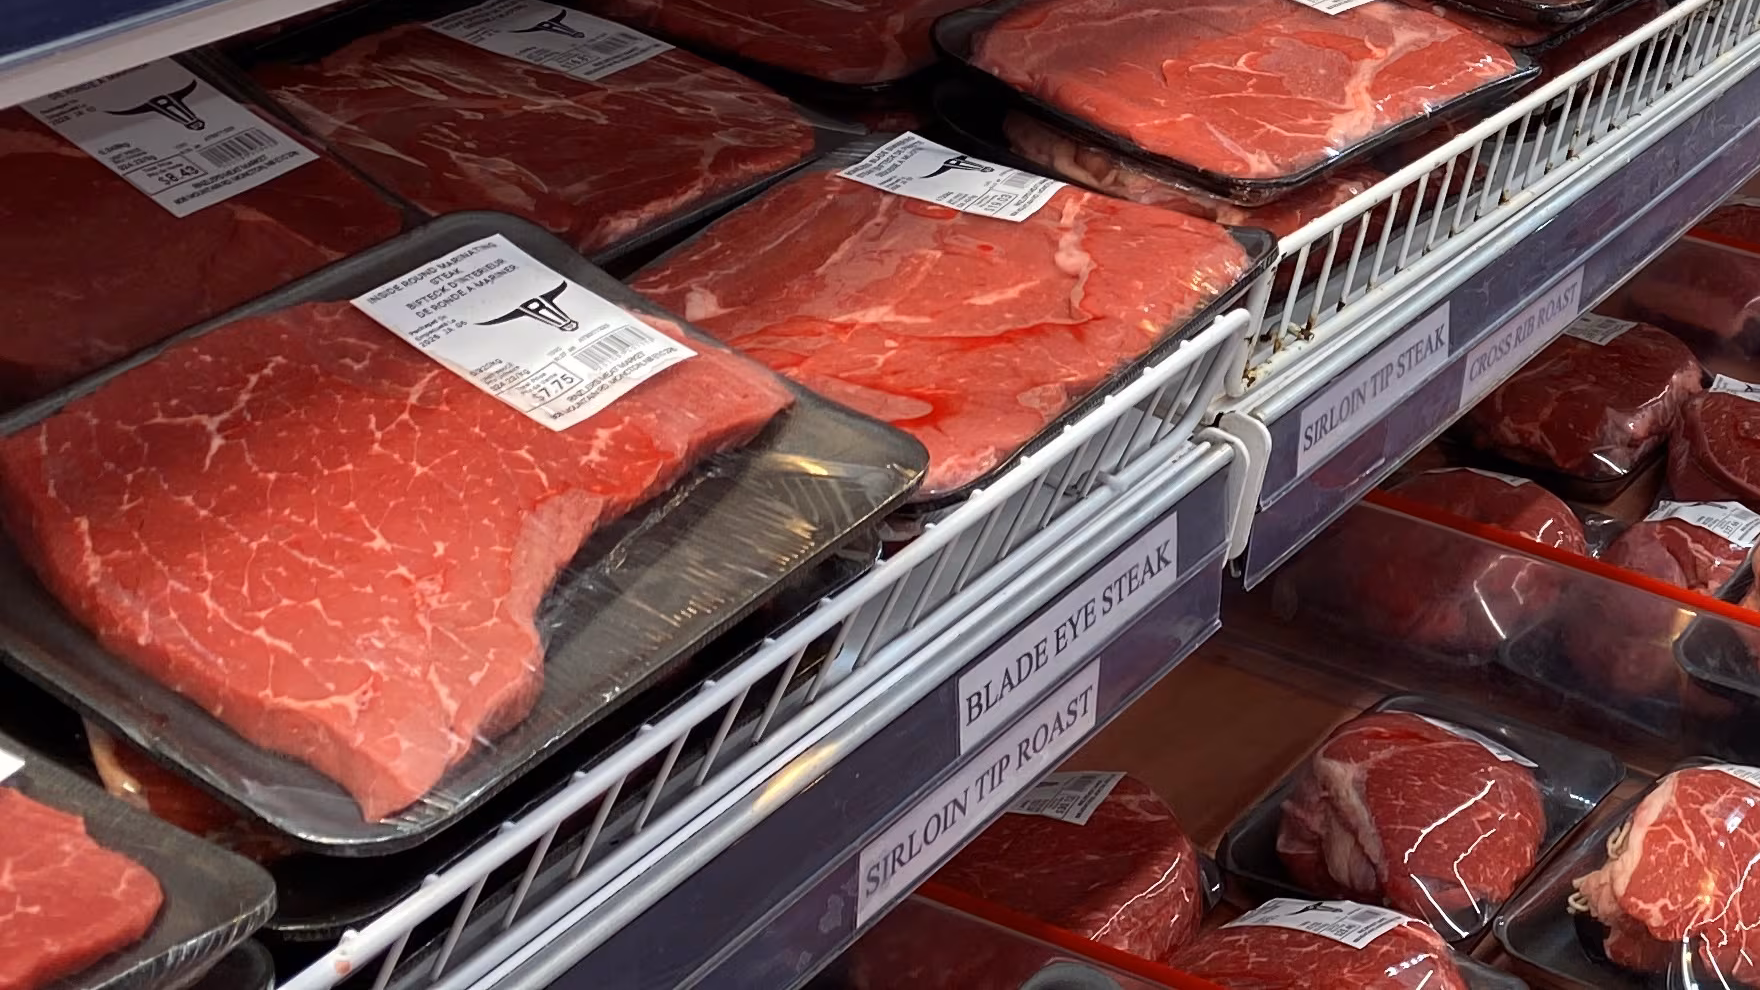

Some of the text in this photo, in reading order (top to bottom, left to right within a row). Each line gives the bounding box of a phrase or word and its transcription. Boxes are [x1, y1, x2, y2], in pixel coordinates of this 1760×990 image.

[158, 165, 199, 186] $8.43
[367, 242, 498, 304] INSIDE ROUND MARINATING
[405, 284, 450, 311] BIFTECK
[415, 305, 434, 319] DE
[431, 289, 467, 311] RONDE
[473, 263, 519, 287] MARINER
[429, 267, 464, 286] STEAK
[1468, 281, 1578, 384] CROSS RIB ROAST
[532, 373, 574, 402] $7.75
[1303, 323, 1446, 453] SIRLOIN TIP STEAK
[965, 538, 1174, 728] BLADE EYE STEAK
[865, 684, 1095, 899] SIRLOIN TIP ROAST
